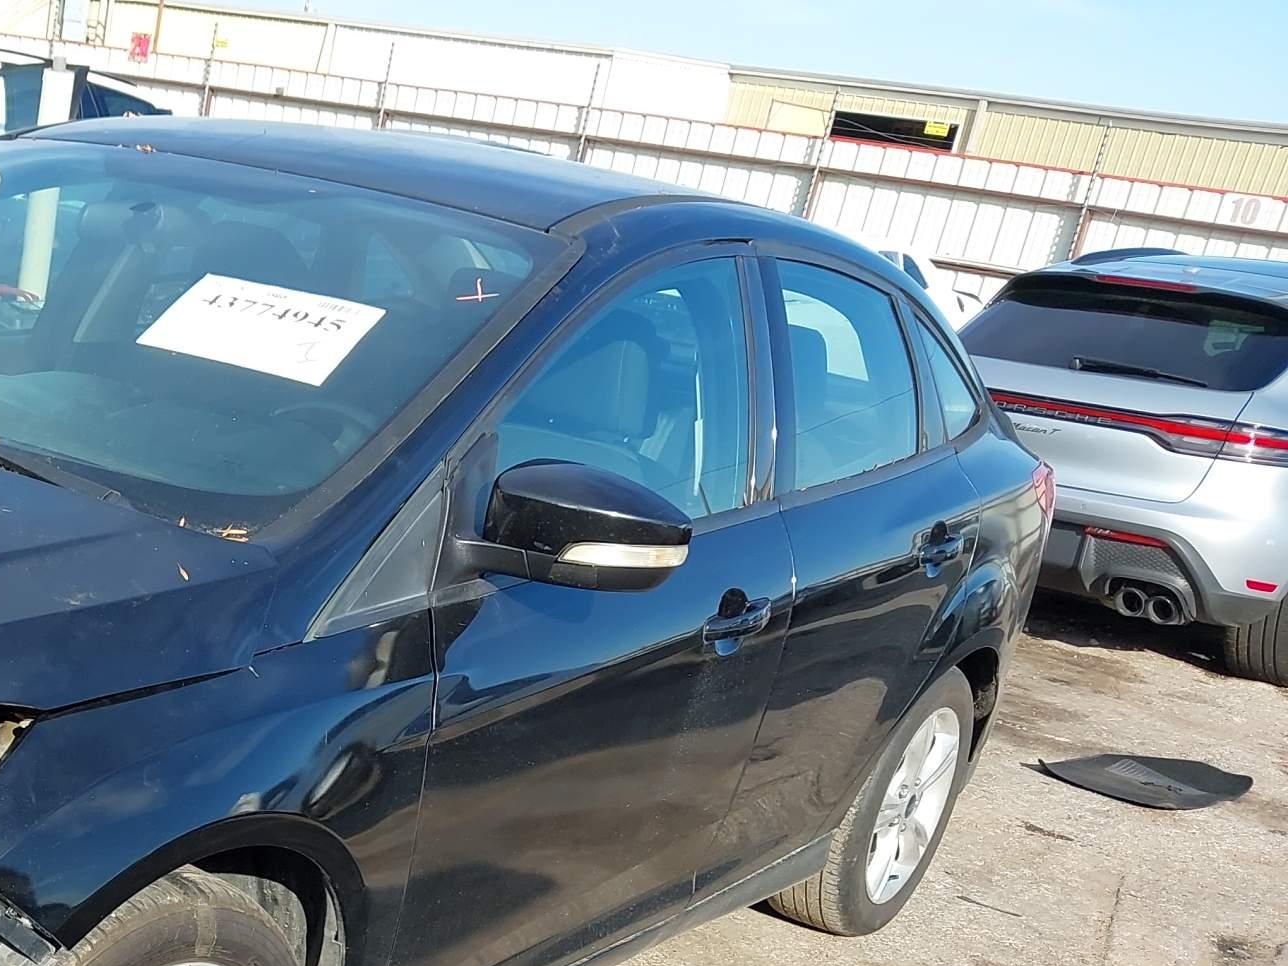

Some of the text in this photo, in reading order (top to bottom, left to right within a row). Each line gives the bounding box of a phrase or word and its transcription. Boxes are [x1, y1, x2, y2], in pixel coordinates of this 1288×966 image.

[1229, 197, 1262, 225] 10
[200, 294, 348, 332] 43774945
[994, 400, 1113, 425] ORSCHE
